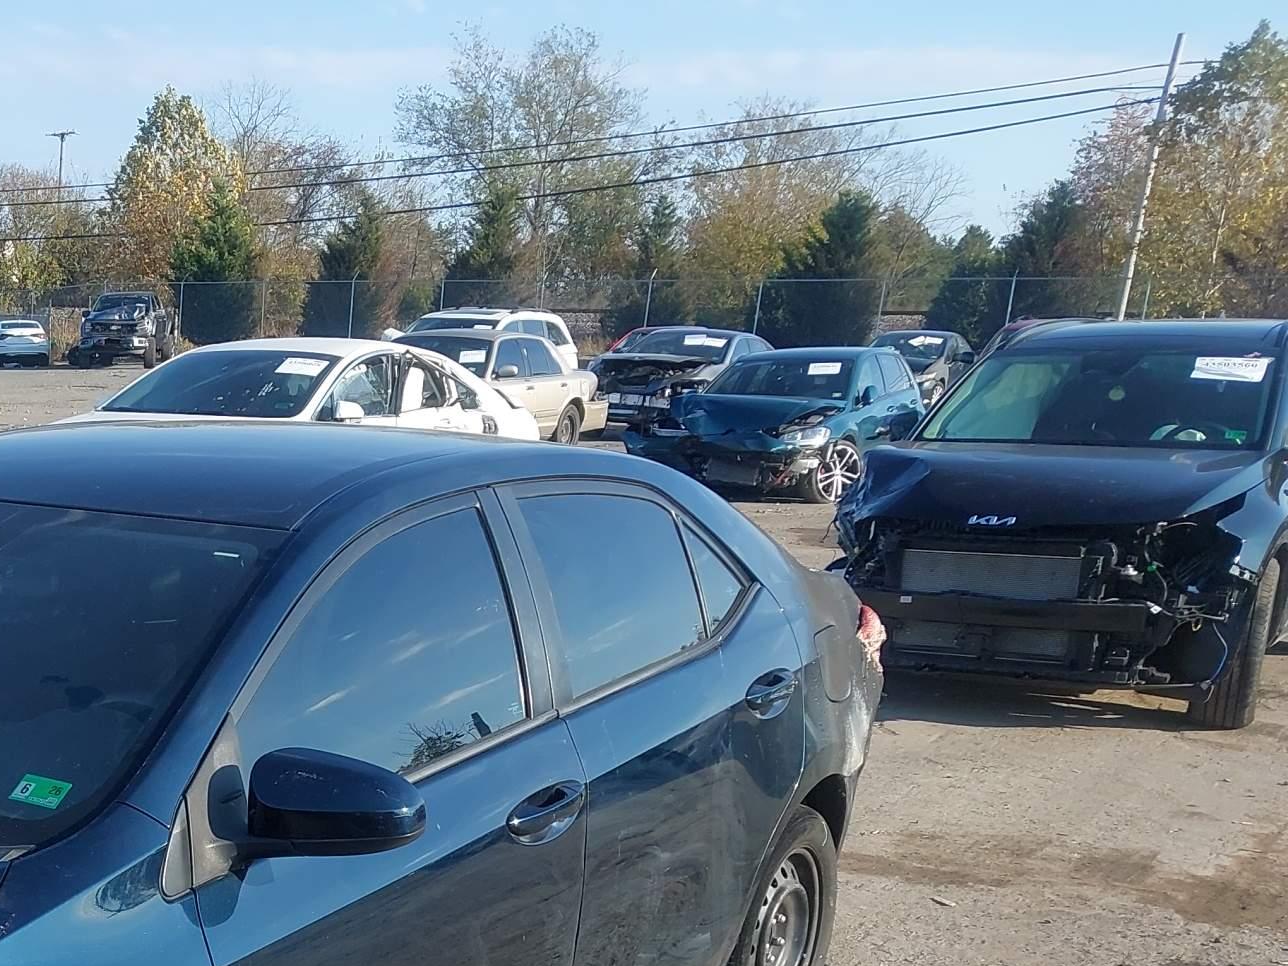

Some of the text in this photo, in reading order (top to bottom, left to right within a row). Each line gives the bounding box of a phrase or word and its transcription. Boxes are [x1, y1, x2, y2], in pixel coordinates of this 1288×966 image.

[967, 514, 1017, 526] KIA
[21, 783, 64, 796] 6 26
